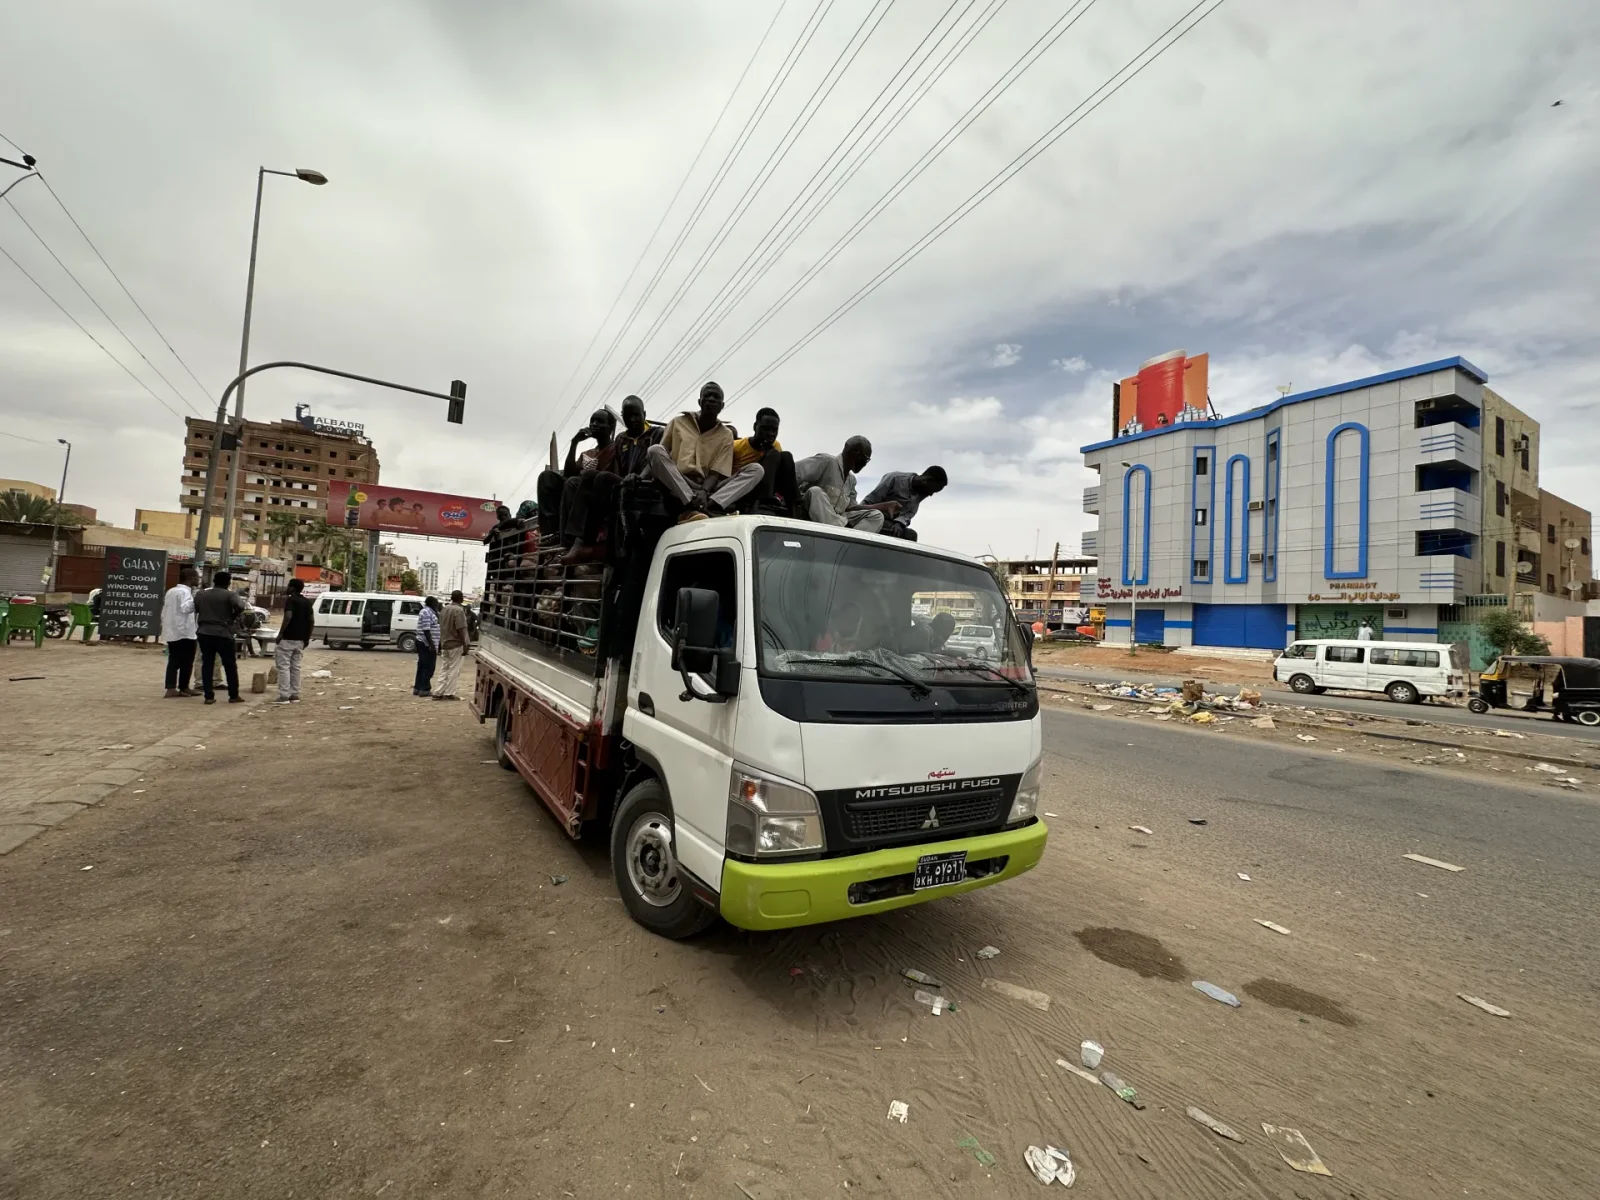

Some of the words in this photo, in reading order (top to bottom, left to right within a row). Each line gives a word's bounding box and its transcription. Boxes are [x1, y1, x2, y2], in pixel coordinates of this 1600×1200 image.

[316, 417, 364, 430] ALBADRI
[316, 425, 363, 436] POWER
[423, 561, 438, 569] GO
[1329, 582, 1377, 590] PHARMACY
[119, 620, 148, 629] 2642
[855, 782, 957, 799] MITSUBISHI
[961, 777, 1001, 789] FUSO
[916, 875, 933, 887] 9KH
